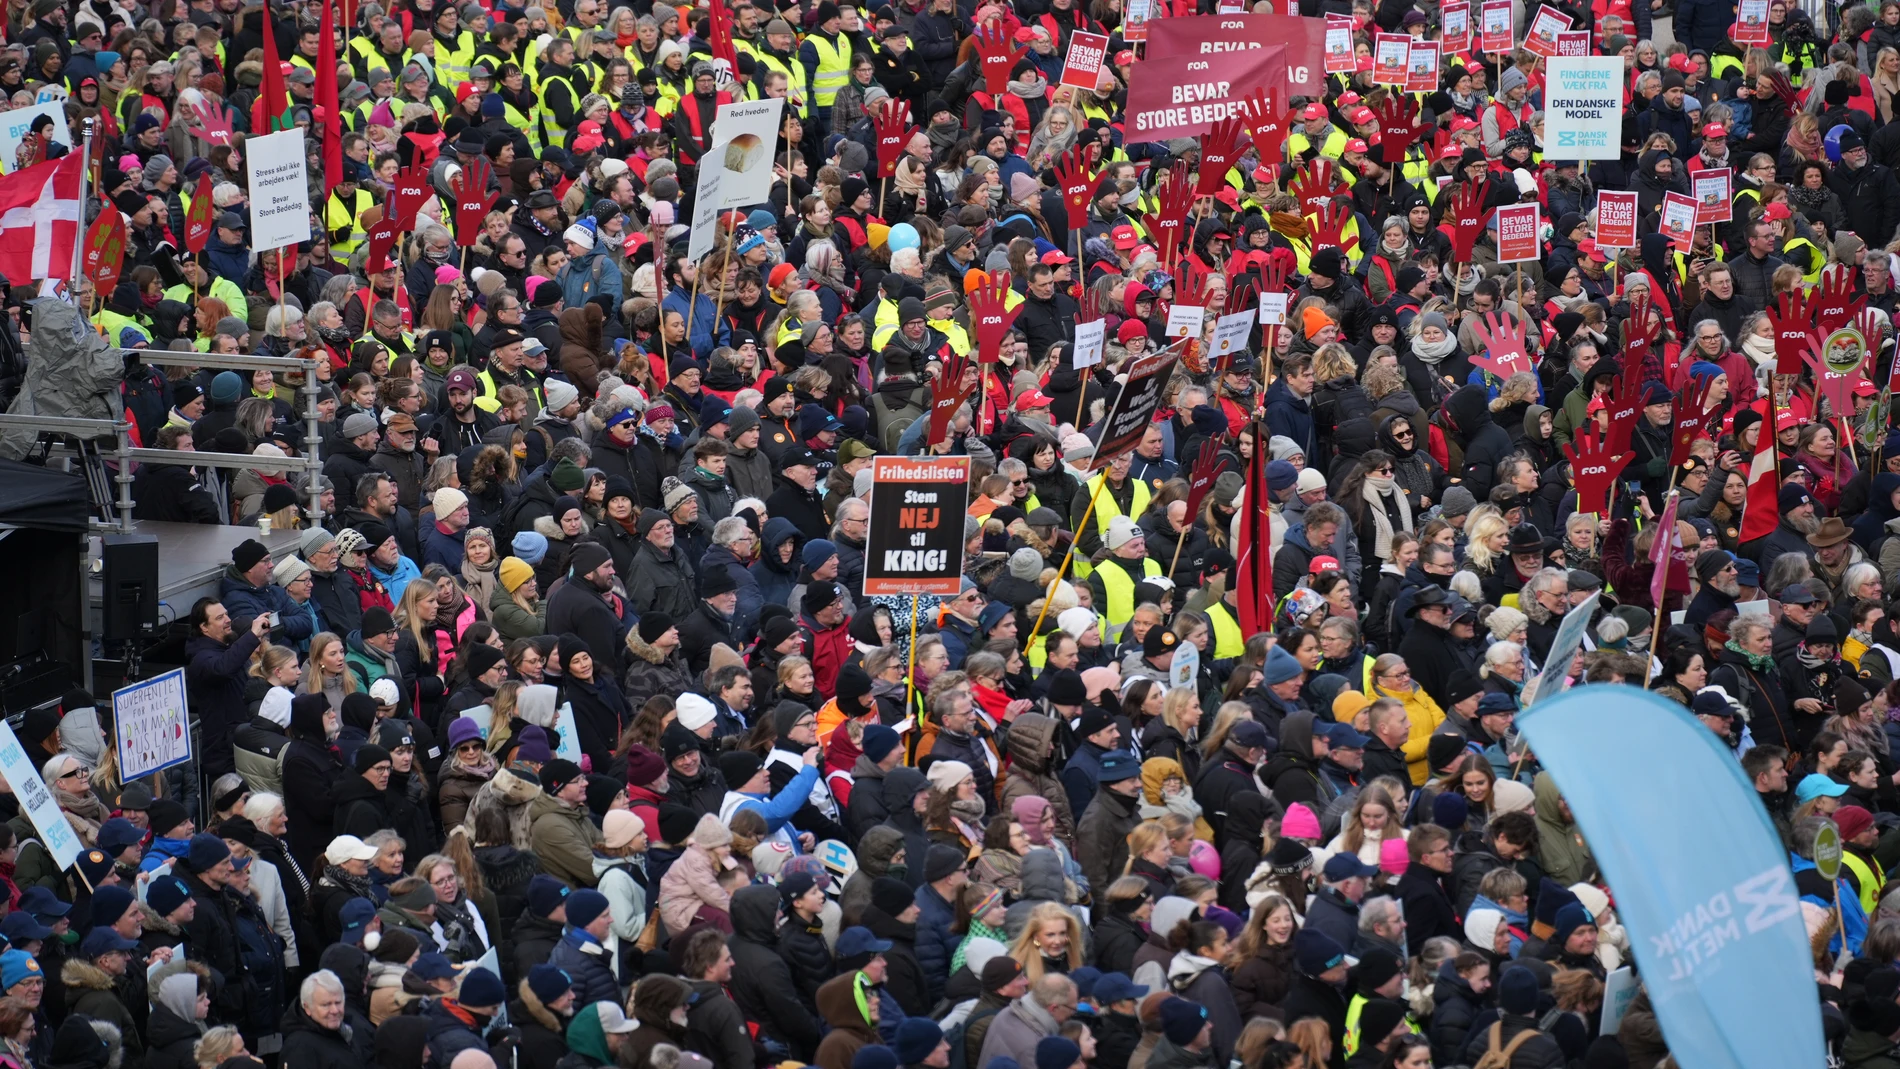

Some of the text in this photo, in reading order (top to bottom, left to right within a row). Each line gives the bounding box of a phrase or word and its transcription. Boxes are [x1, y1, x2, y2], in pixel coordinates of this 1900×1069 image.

[1220, 21, 1244, 29] FOA
[1559, 40, 1586, 49] BEVAR
[1071, 44, 1102, 58] BEVAR
[987, 56, 1007, 64] FOA
[1069, 53, 1100, 68] STORE
[1187, 61, 1209, 70] FOA
[1067, 62, 1098, 73] BEDEDAG
[1560, 71, 1611, 79] FINGRENE
[1563, 81, 1607, 90] VÆK FRA
[1172, 81, 1230, 104] BEVAR
[1553, 100, 1616, 108] DEN DANSKE
[730, 107, 769, 118] Red hveden
[1358, 109, 1370, 117] FOA
[1566, 110, 1602, 119] MODEL
[1136, 108, 1188, 130] STORE
[1257, 124, 1277, 134] FOA
[255, 161, 300, 177] Stress skal ikke
[1259, 166, 1271, 174] FOA
[258, 172, 299, 188] arbejdes væk!
[1068, 184, 1086, 195] FOA
[272, 195, 289, 204] Bevar
[259, 202, 302, 217] Store Bededag
[1601, 201, 1633, 211] BEVAR
[1601, 210, 1632, 219] STORE
[1502, 215, 1533, 226] BEVAR
[189, 224, 202, 235] dbio
[1502, 224, 1534, 234] STORE
[375, 231, 391, 239] FOA
[1502, 232, 1534, 240] BEDEDAG
[624, 239, 636, 247] FOA
[88, 250, 99, 261] dbi
[99, 266, 111, 277] dbio
[983, 316, 1001, 324] FOA
[1630, 338, 1644, 348] FOA
[1497, 352, 1520, 365] FOA
[937, 398, 954, 408] FOA
[1615, 408, 1634, 420] FOA
[1115, 415, 1145, 437] Forum
[1680, 419, 1698, 428] FOA
[880, 466, 964, 479] Frihedslisten
[1582, 466, 1606, 475] FOA
[904, 490, 937, 503] Stem
[899, 508, 940, 528] NEJ
[910, 532, 926, 546] til
[884, 550, 947, 571] KRIG!
[133, 698, 168, 719] FOR ALLE
[1, 742, 22, 769] BEVAR
[129, 740, 179, 772] UKRAINE
